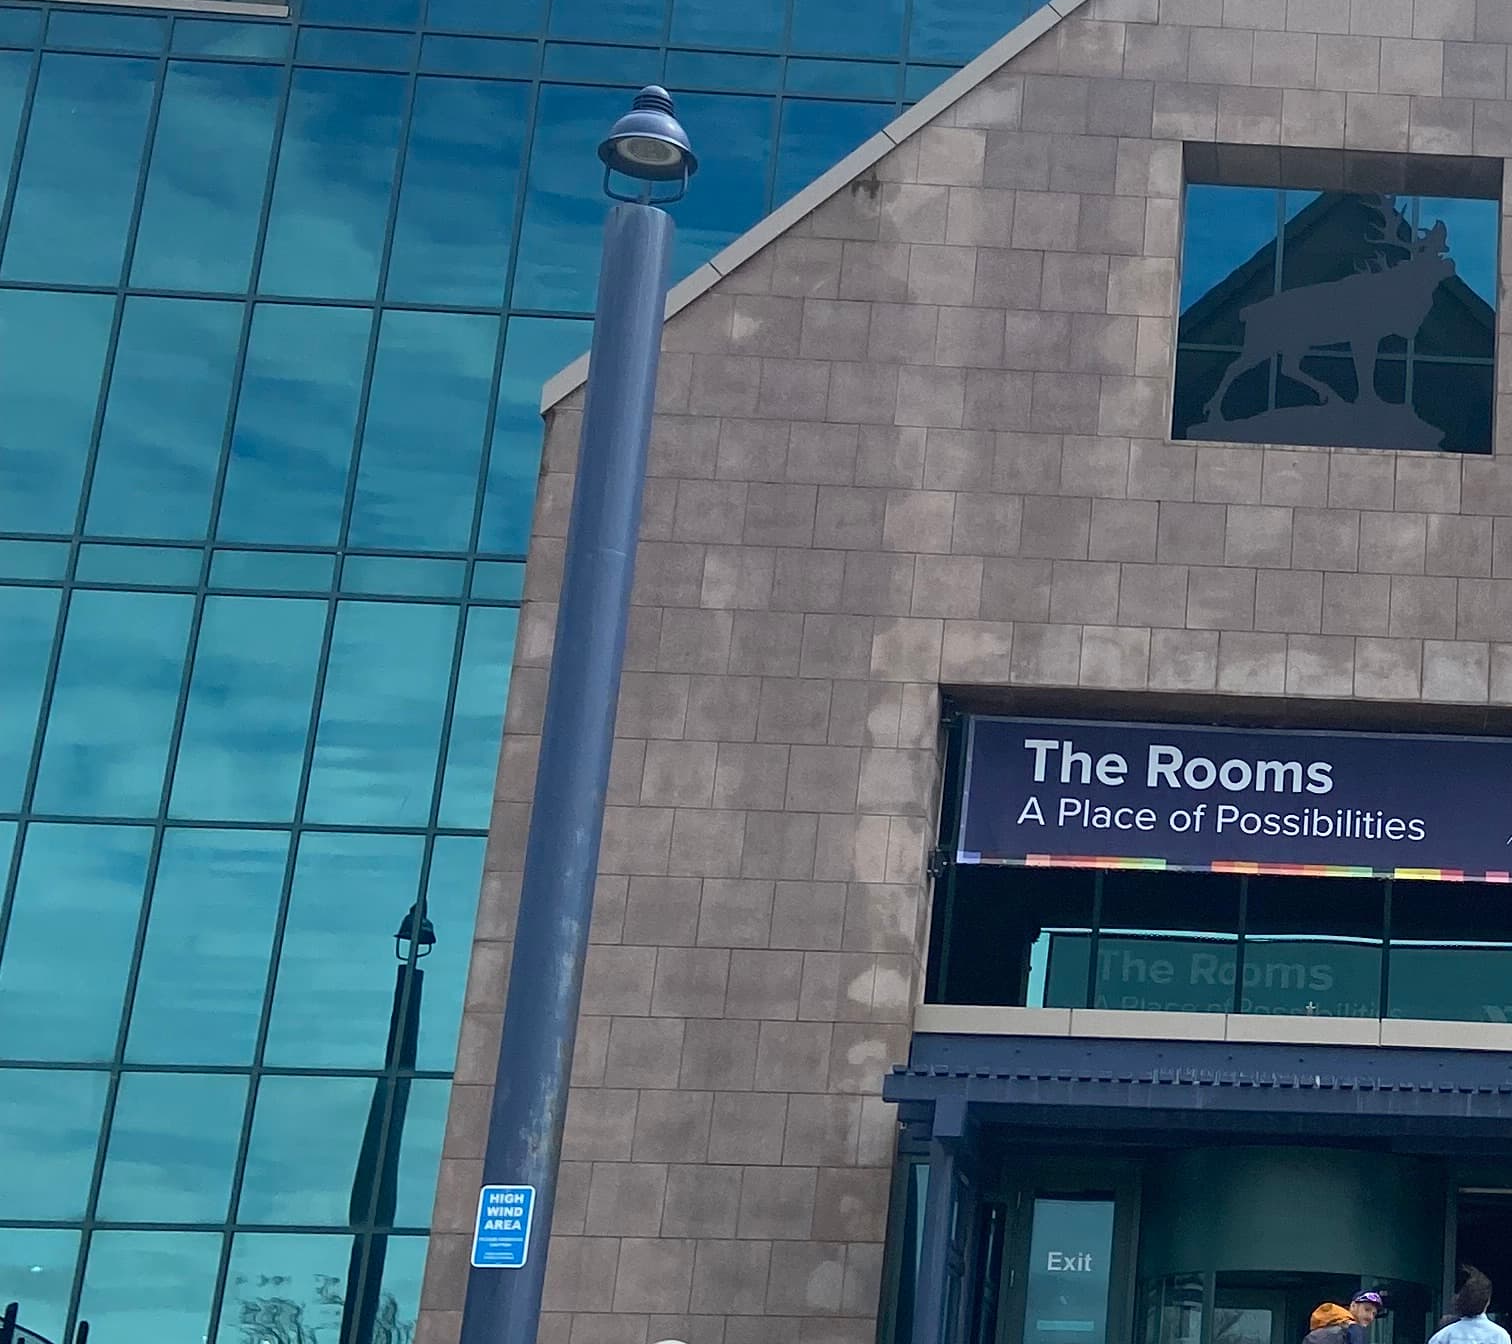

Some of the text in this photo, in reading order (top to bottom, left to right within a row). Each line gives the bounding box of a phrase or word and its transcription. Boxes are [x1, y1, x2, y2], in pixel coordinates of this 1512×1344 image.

[1024, 739, 1335, 795] The Rooms
[1017, 795, 1427, 842] A Place of Possibilities
[1099, 949, 1335, 992] The Rooms
[489, 1193, 525, 1204] HIGH
[487, 1206, 524, 1217] WIND
[484, 1219, 522, 1230] AREA
[1047, 1251, 1093, 1272] Exit
